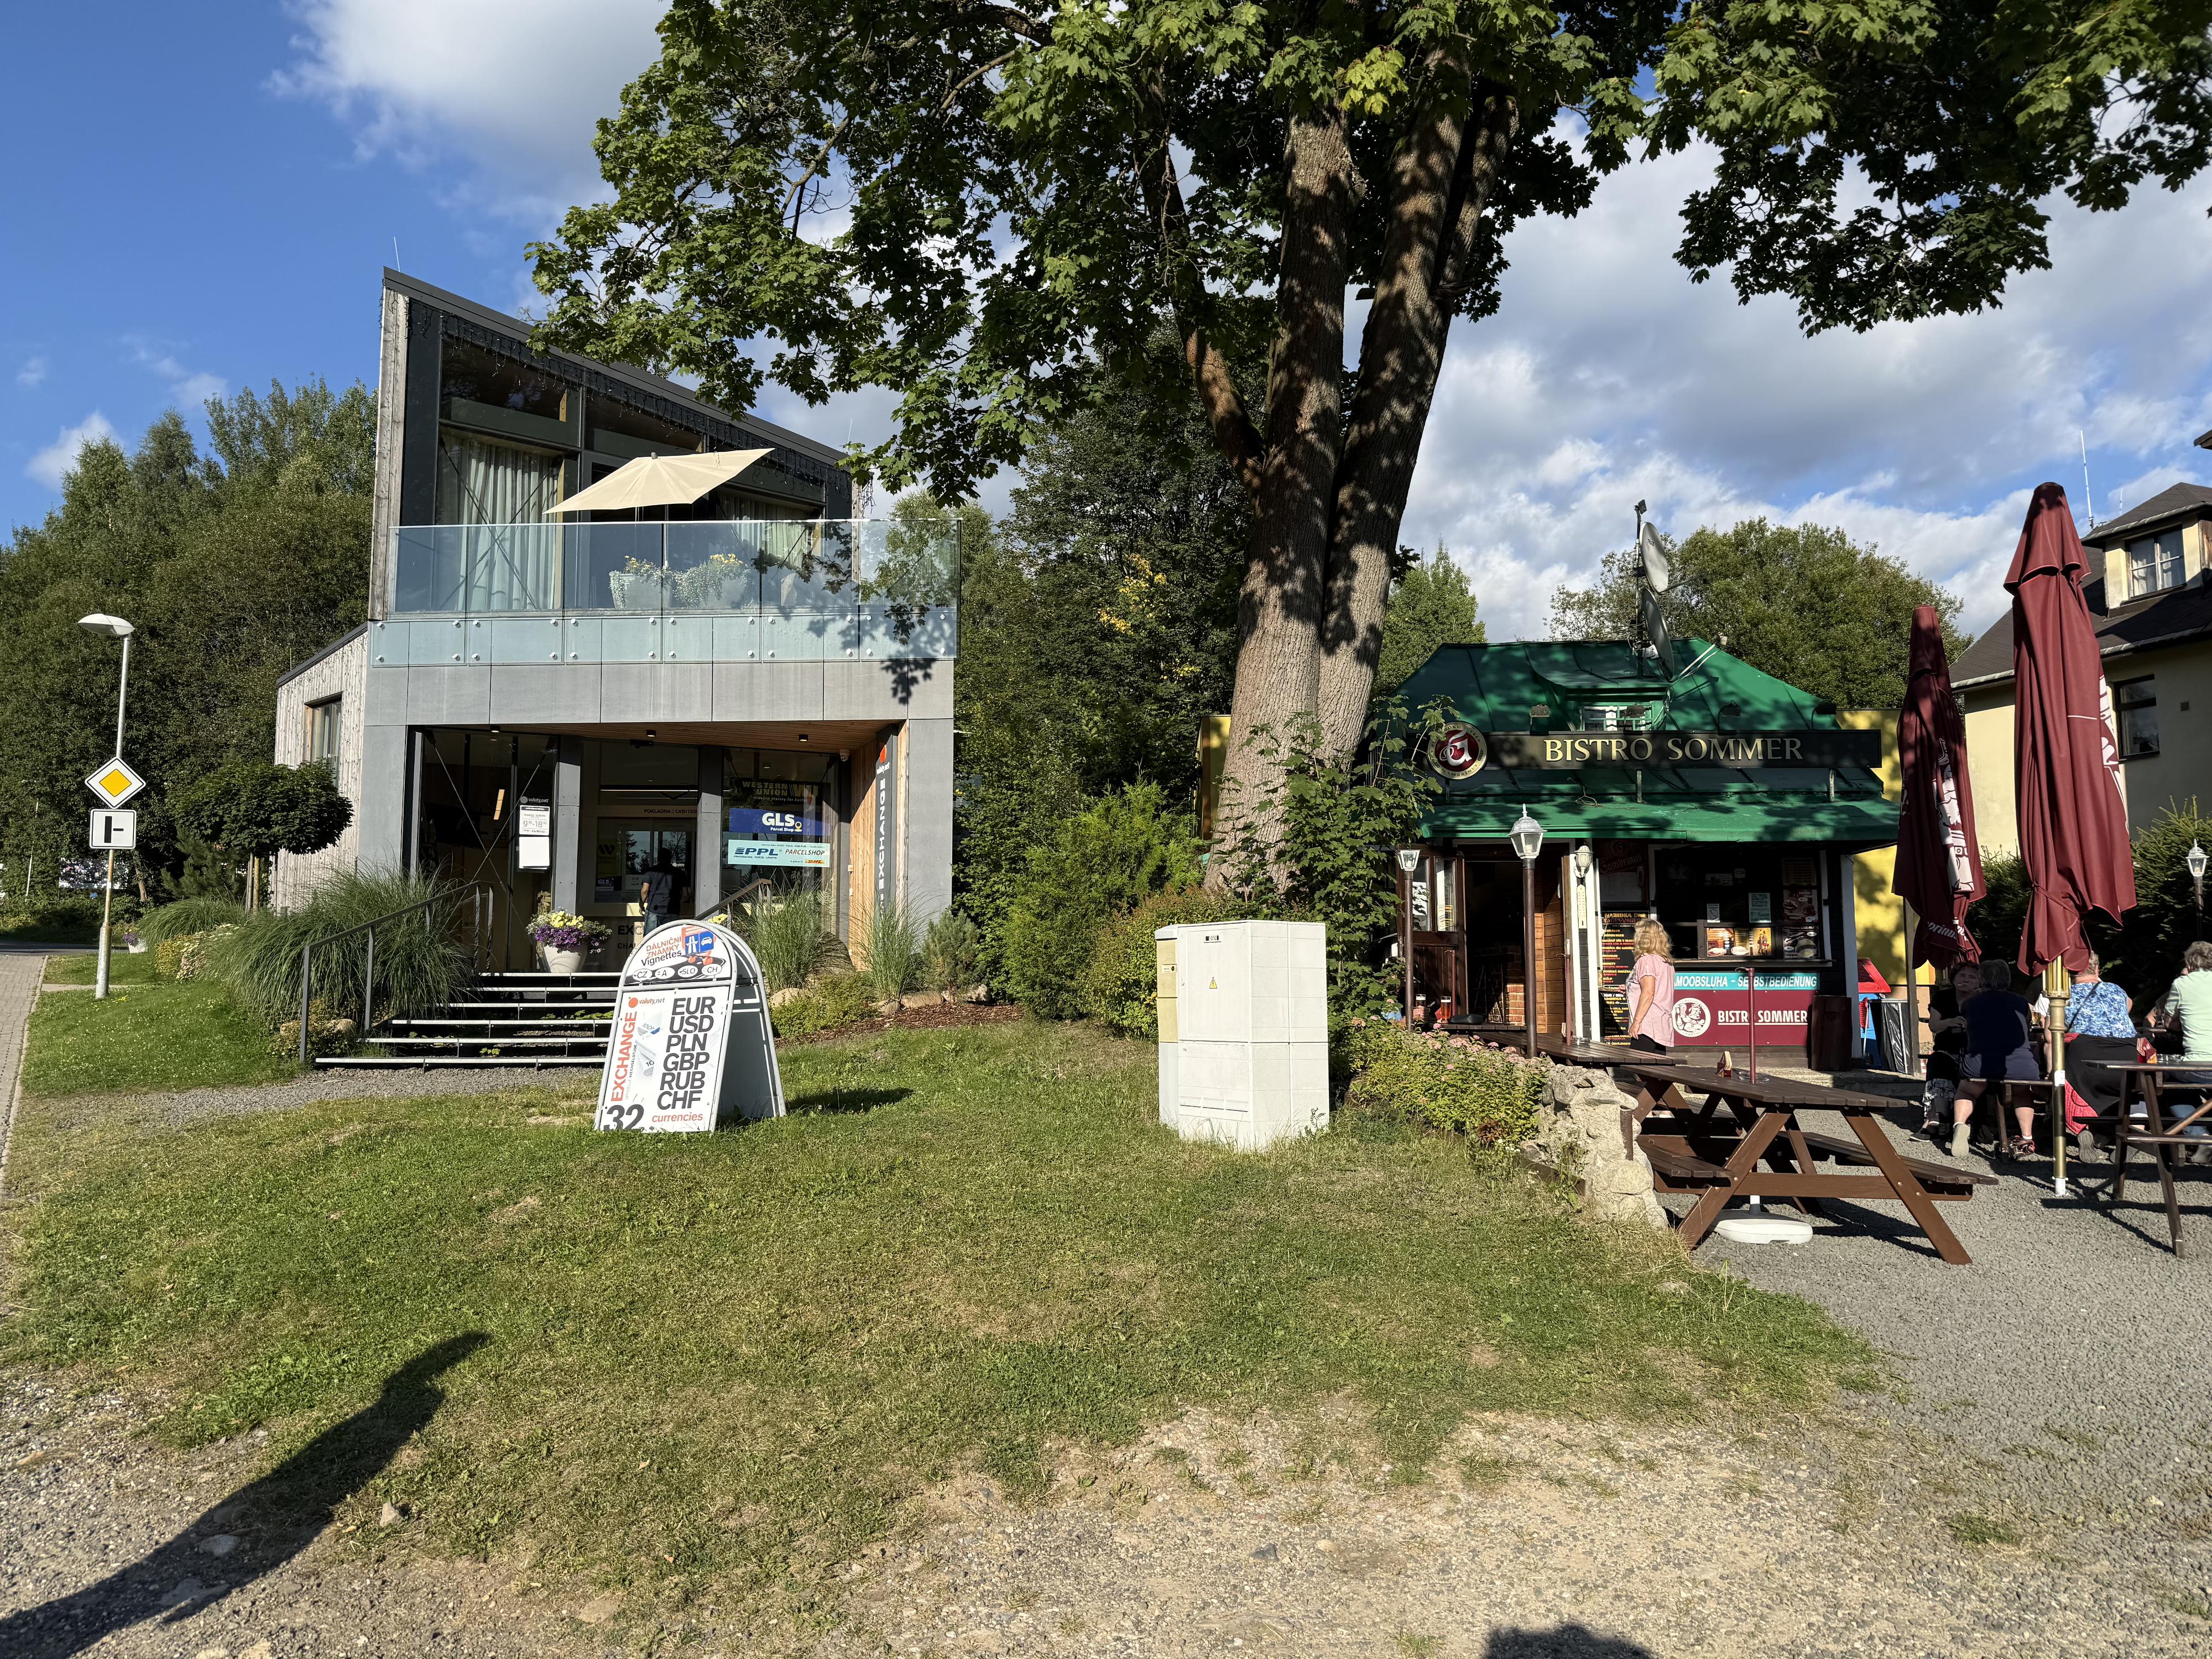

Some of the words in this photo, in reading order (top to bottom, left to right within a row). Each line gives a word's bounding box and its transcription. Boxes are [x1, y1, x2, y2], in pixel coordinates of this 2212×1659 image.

[1543, 738, 1653, 761] BISTRO
[1667, 737, 1804, 761] SOMMER
[742, 781, 788, 790] WESTERN
[761, 812, 795, 827] GLS
[745, 848, 779, 856] PPL
[641, 950, 682, 966] Vignettes
[1673, 976, 1728, 987] MOOBSLUHA
[1737, 976, 1817, 988] SEBSTBEDIENUNG
[671, 997, 716, 1016] EUR
[669, 1015, 714, 1034] USD
[1718, 1010, 1752, 1023] BISTR
[1757, 1010, 1808, 1023] SOMMER
[666, 1033, 708, 1053] PLN
[611, 1011, 637, 1102] EXCHANGE
[663, 1052, 710, 1072] GBP
[660, 1071, 706, 1091] RUB
[657, 1090, 702, 1110] CHF
[603, 1104, 644, 1131] 32
[651, 1113, 703, 1123] currencies
